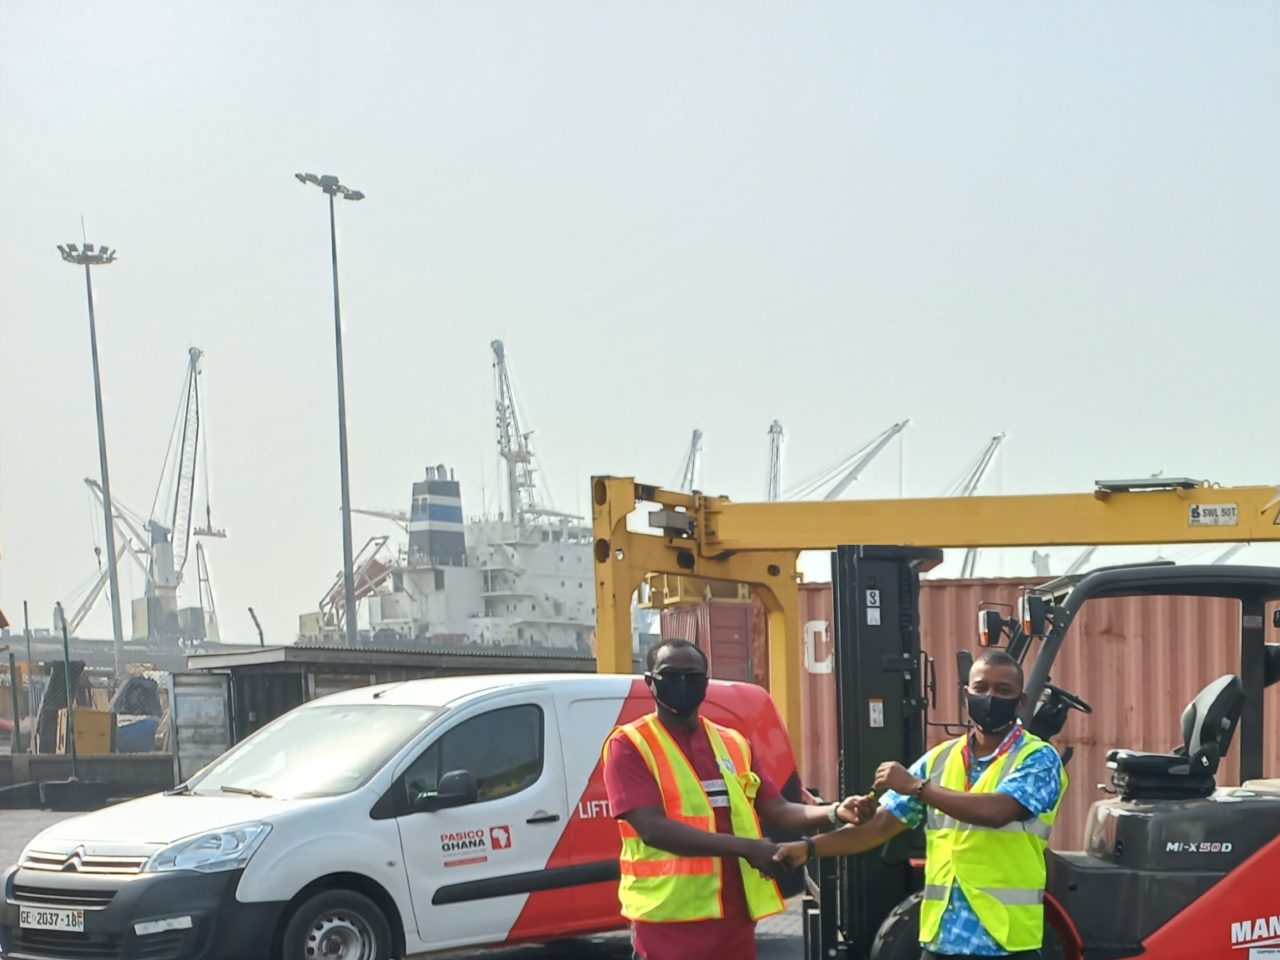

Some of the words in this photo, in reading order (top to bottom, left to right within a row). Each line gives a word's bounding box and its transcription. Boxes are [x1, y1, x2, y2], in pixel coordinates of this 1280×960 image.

[440, 829, 485, 842] PASICO
[441, 838, 486, 852] GHANA
[1165, 841, 1233, 853] MI-X50D
